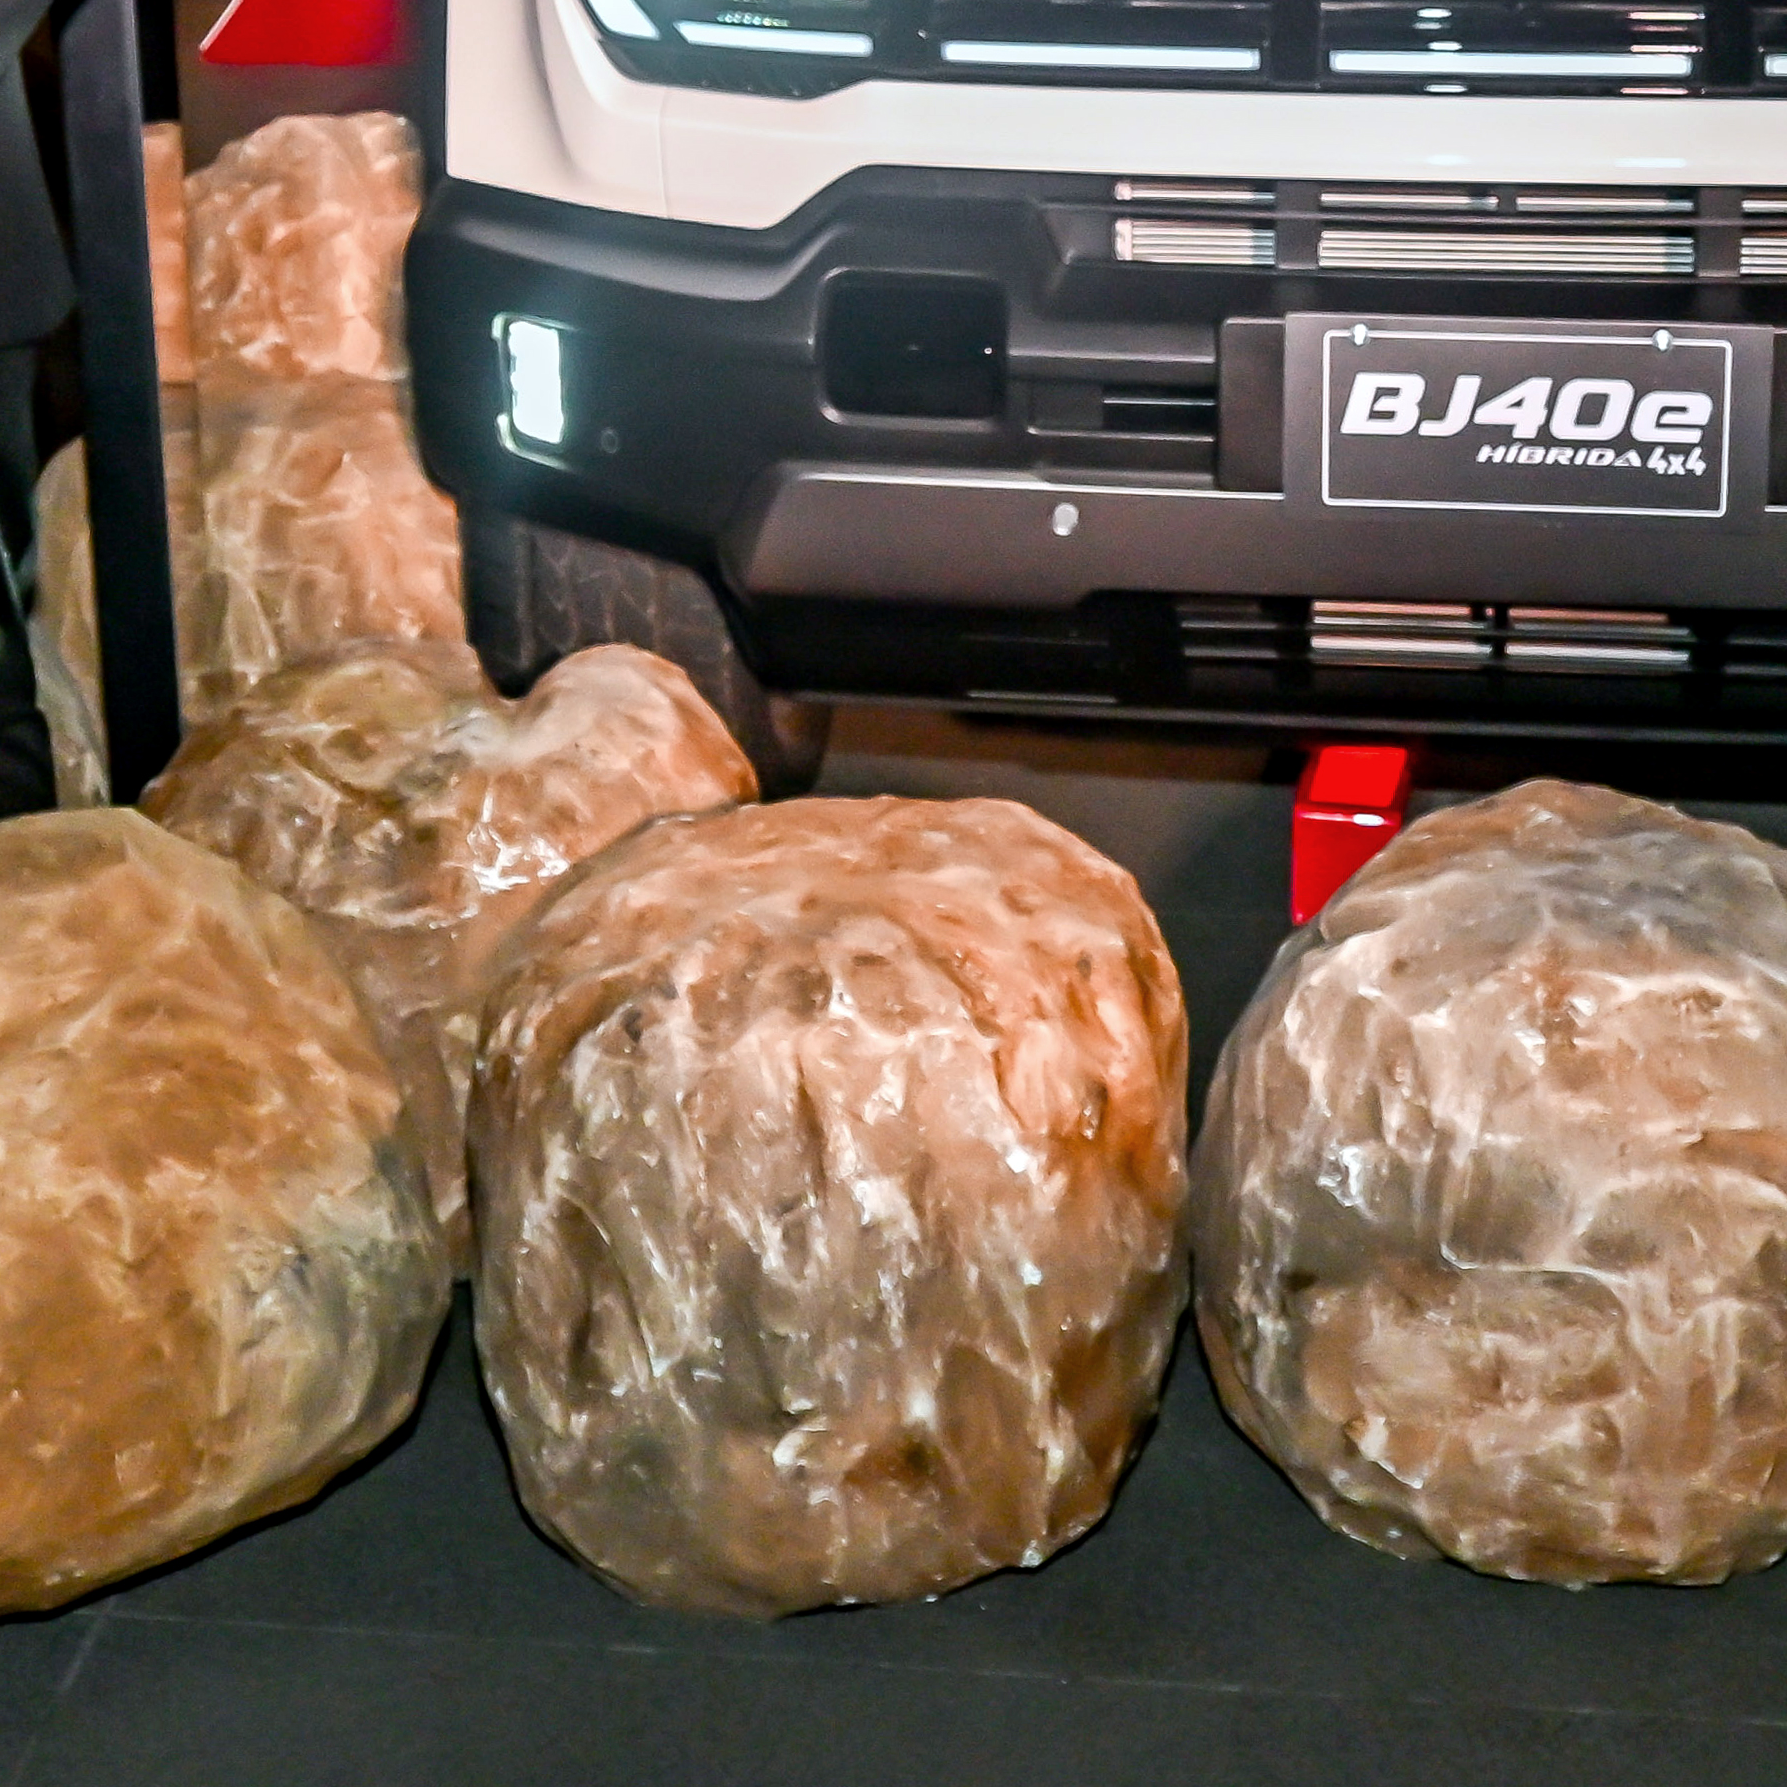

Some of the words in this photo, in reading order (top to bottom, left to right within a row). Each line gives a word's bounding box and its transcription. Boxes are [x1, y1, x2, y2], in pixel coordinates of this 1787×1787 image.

[1339, 371, 1714, 444] BJ40e
[1475, 441, 1642, 468] HÍBRIDA
[1646, 445, 1707, 476] 4x4
